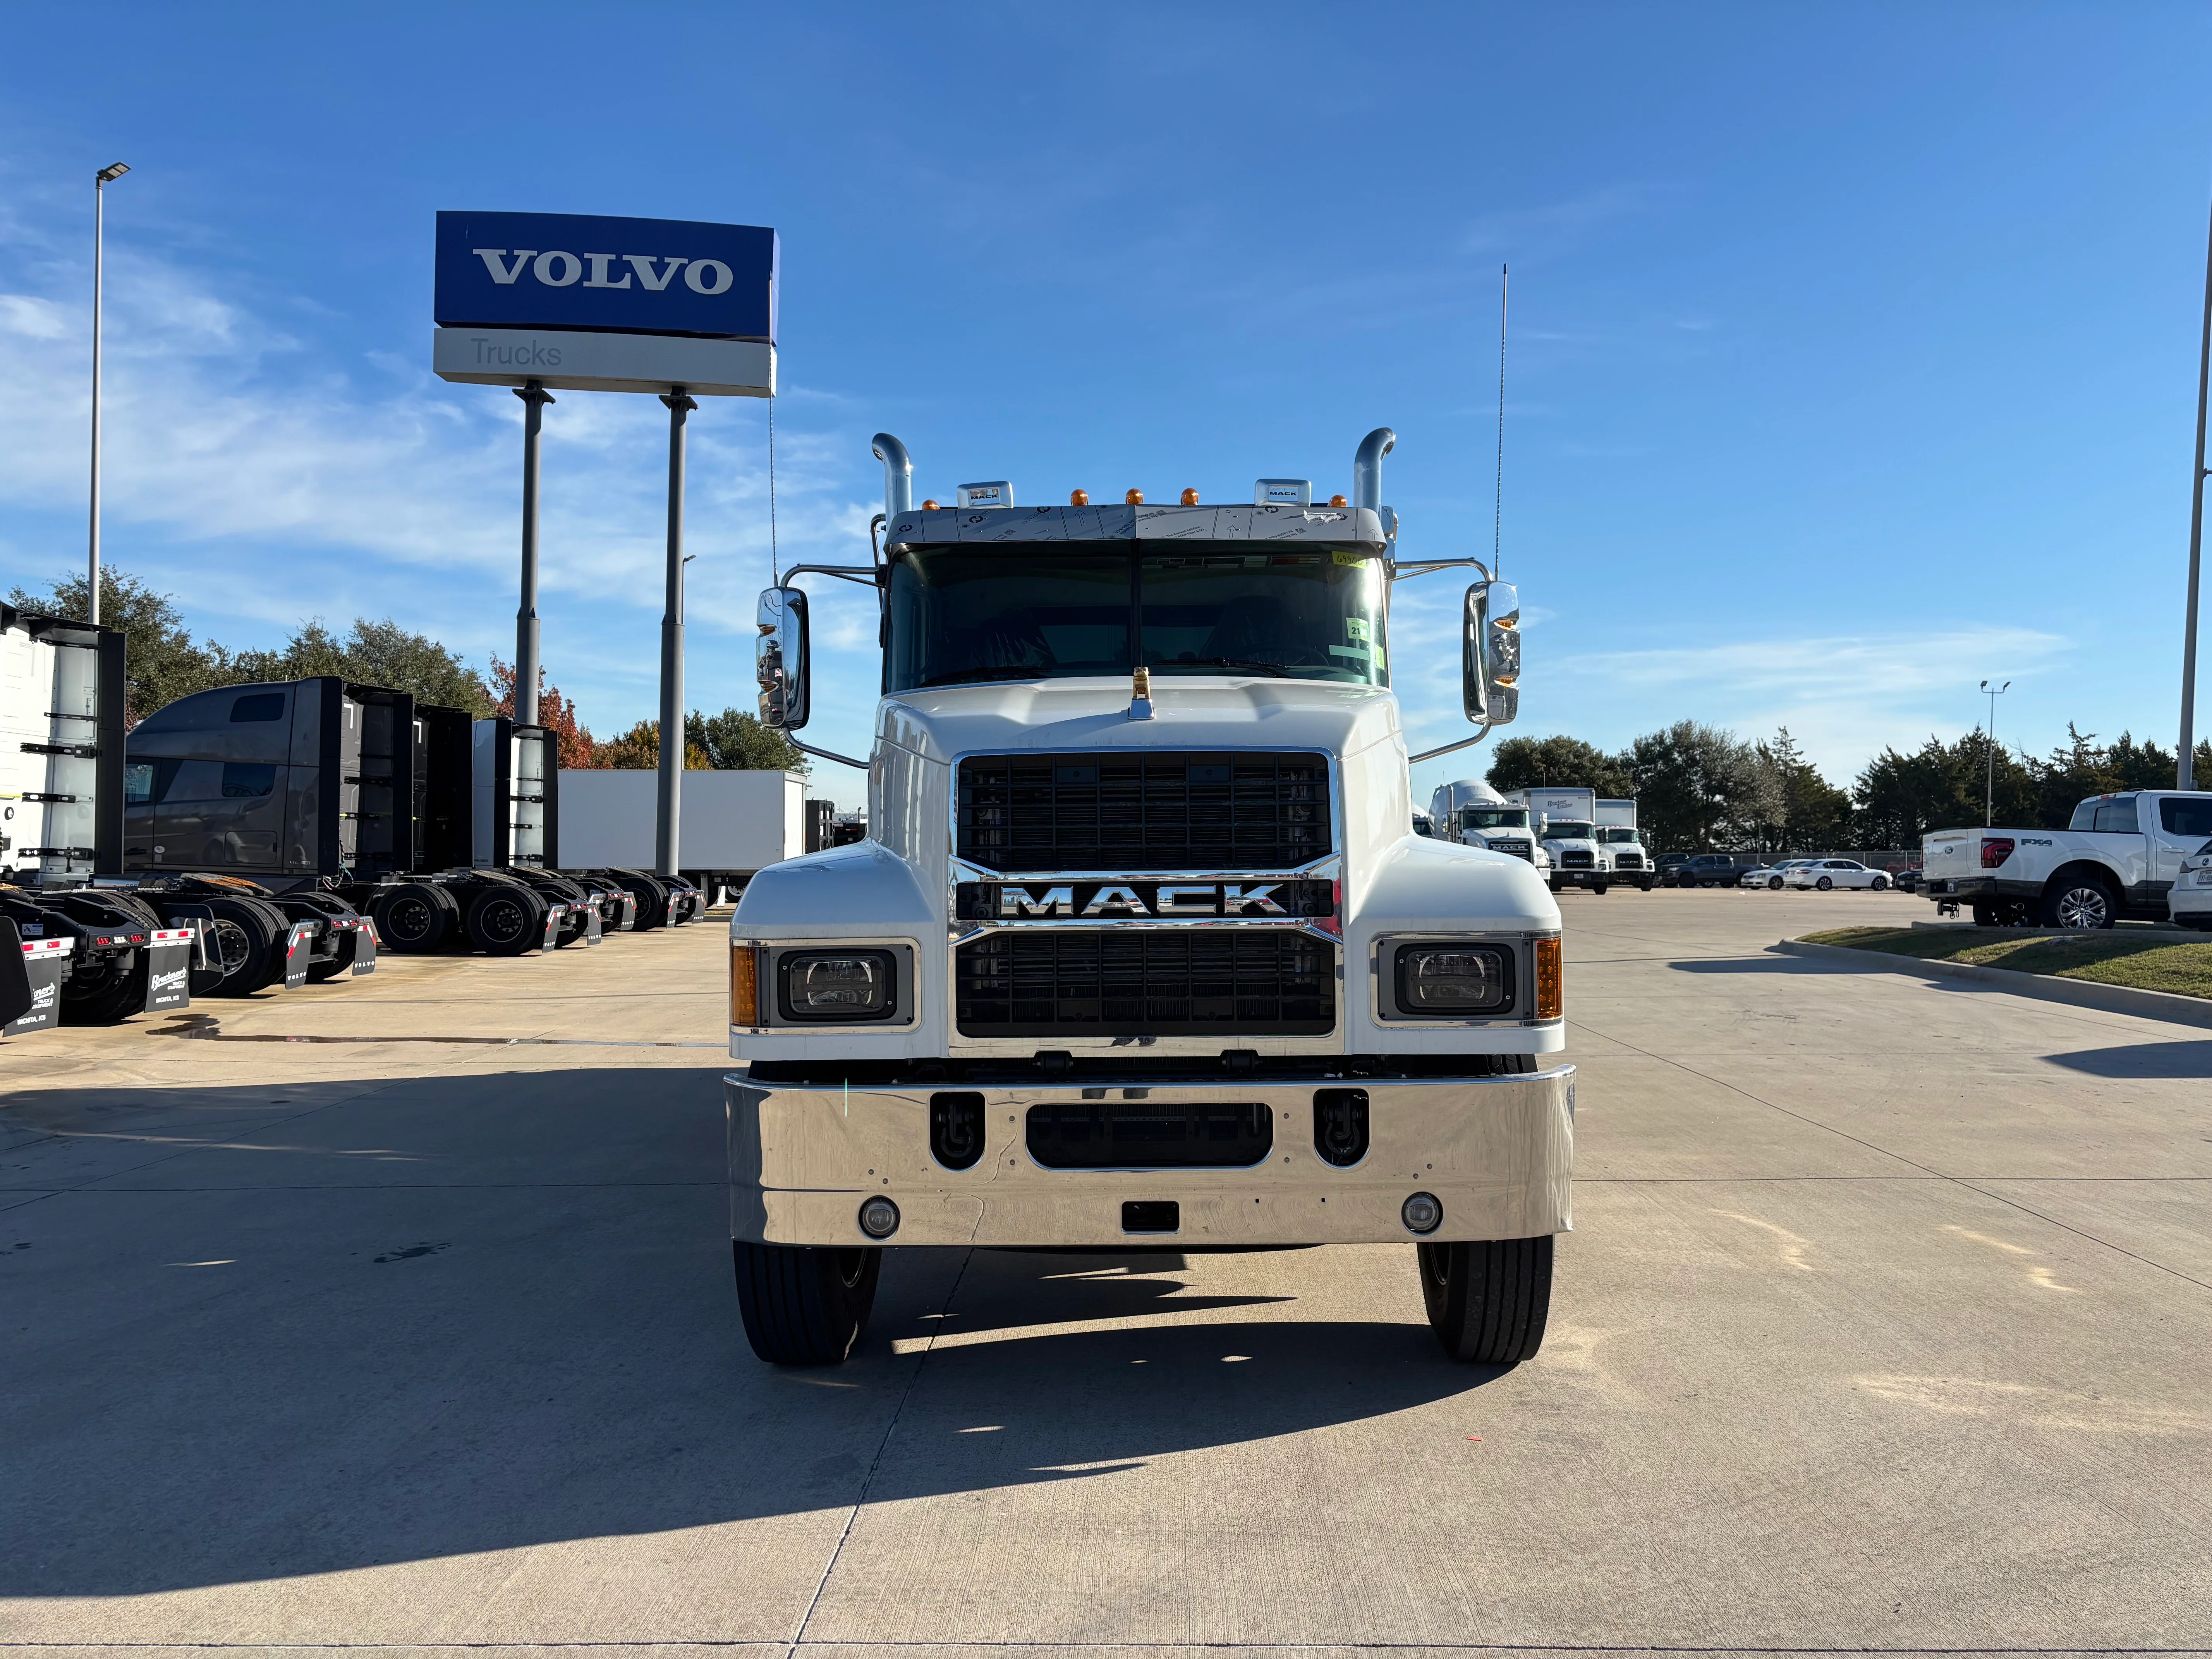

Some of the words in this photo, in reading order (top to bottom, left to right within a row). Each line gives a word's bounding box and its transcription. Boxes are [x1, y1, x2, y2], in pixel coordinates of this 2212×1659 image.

[473, 249, 733, 295] VOLVO
[471, 338, 562, 366] Trucks
[1001, 883, 1288, 915] MACK
[287, 971, 306, 981] VOLVO
